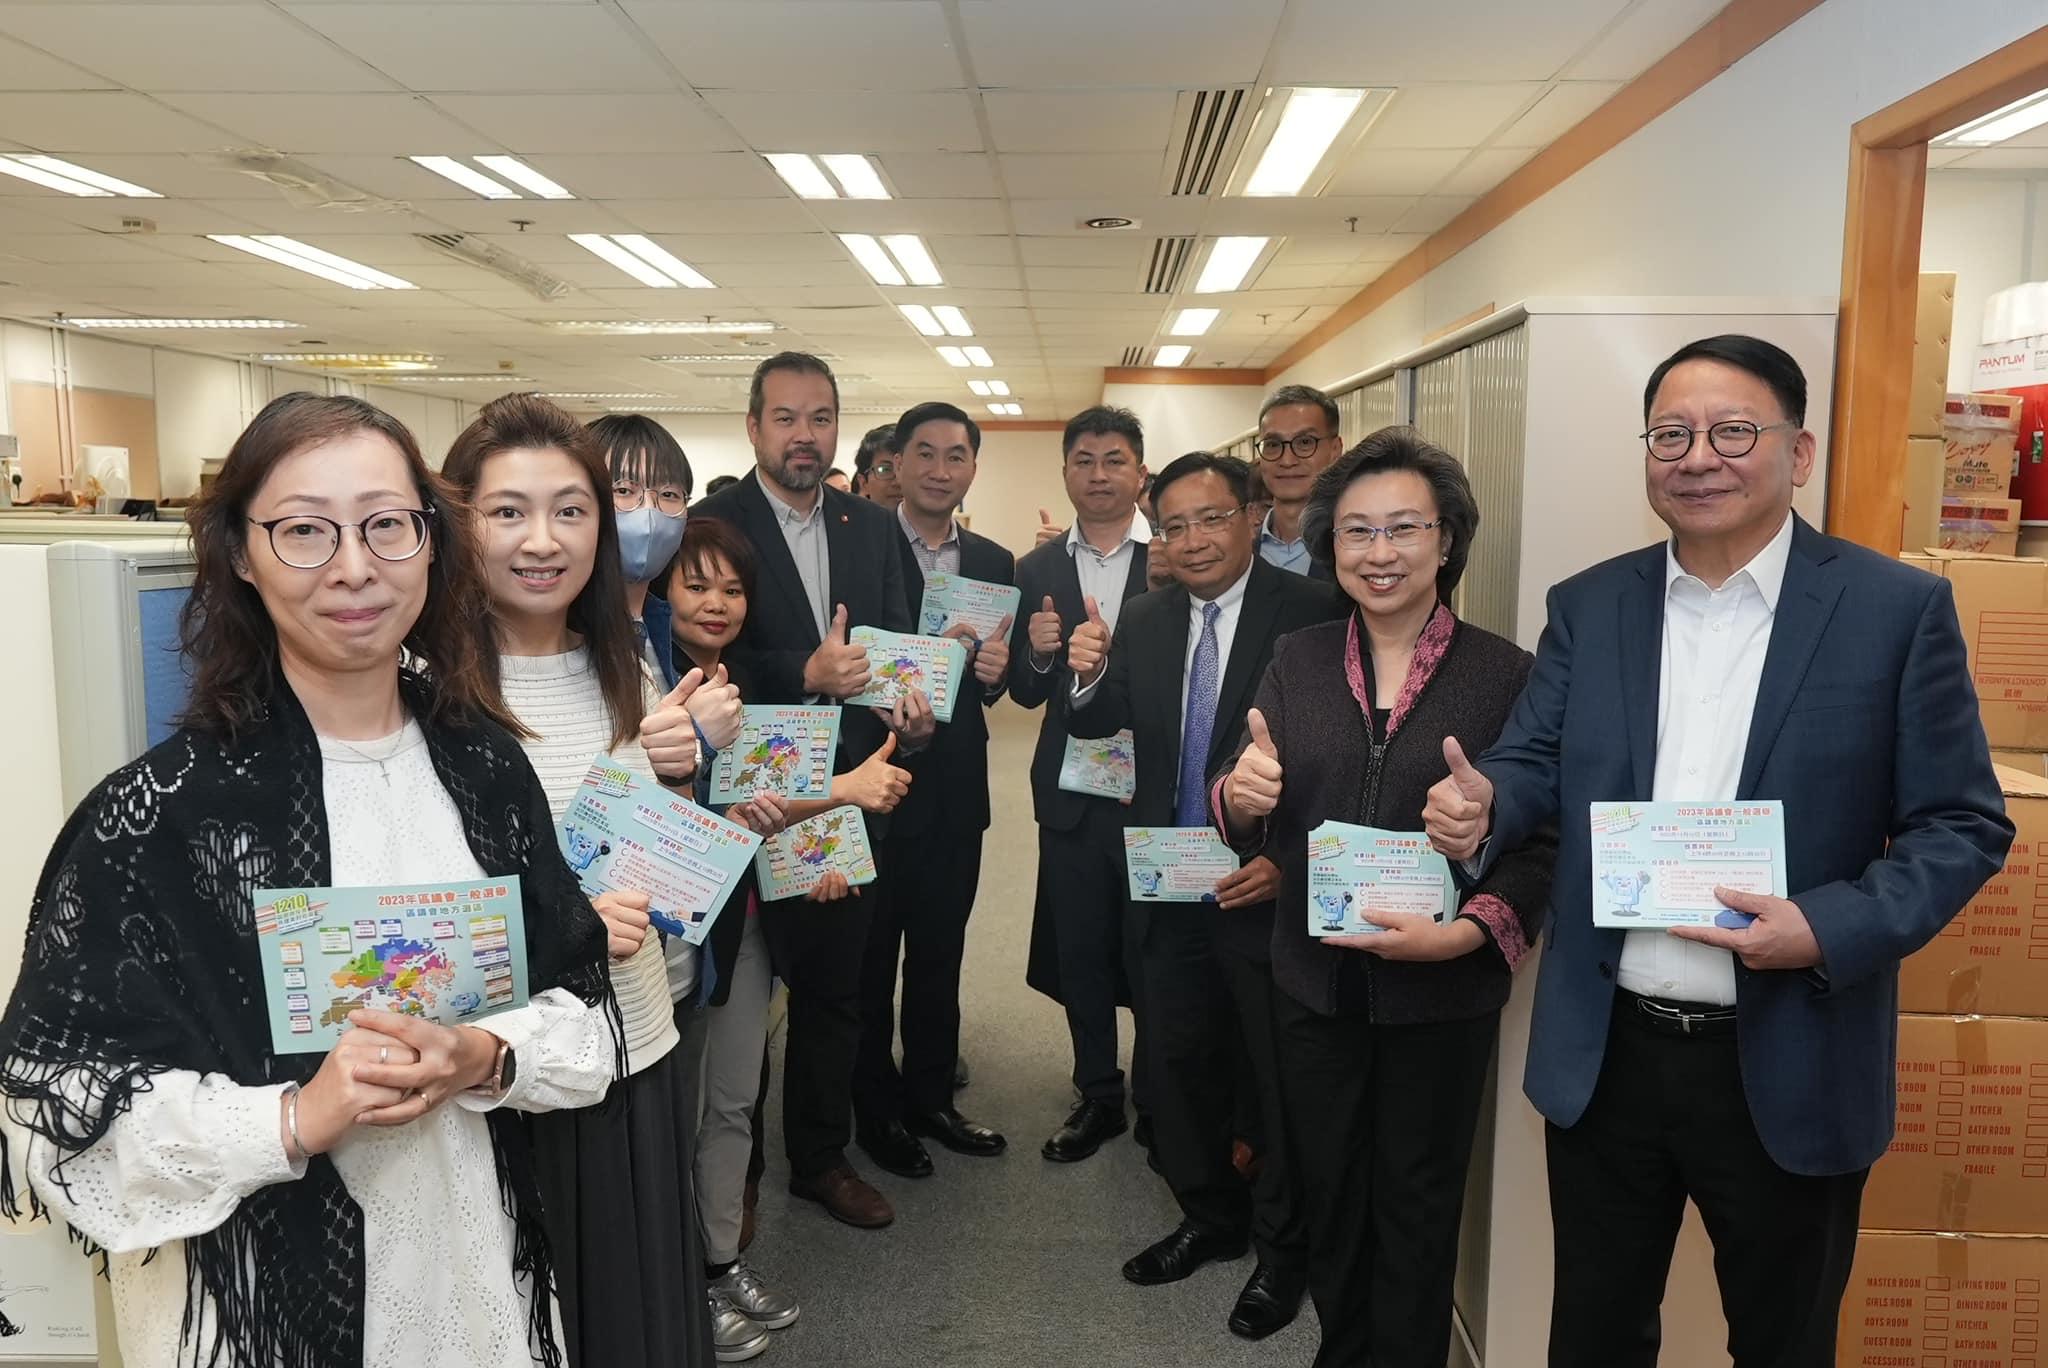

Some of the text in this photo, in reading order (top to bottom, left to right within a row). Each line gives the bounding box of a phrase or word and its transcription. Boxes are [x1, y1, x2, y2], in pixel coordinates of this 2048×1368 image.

[1979, 354, 2025, 368] PANTUM
[2012, 678, 2046, 686] CONTACT
[1677, 808, 1770, 816] 2023年區議會一般選舉
[2012, 844, 2029, 854] OOM
[2007, 865, 2030, 875] ROOM
[378, 886, 507, 906] 2023年區議會一般選舉
[273, 894, 306, 913] 1210
[406, 903, 483, 917] 區議會地方選區
[1974, 906, 2018, 916] BATH ROOM
[1972, 926, 2021, 937] OTHER ROOM
[1970, 946, 2000, 956] FRAGILE
[1913, 1063, 1935, 1072] ROOM
[1972, 1065, 2021, 1074] LIVING ROOM
[1904, 1083, 1926, 1093] ROOM
[1971, 1085, 2022, 1095] DINING ROOM
[1900, 1103, 1922, 1112] ROOM
[1969, 1105, 2002, 1115] KITCHEN
[1903, 1123, 1925, 1132] ROOM
[1968, 1125, 2010, 1135] BATH ROOM
[1891, 1142, 1928, 1152] ESSORIES
[1966, 1145, 2014, 1155] OTHER ROOM
[1964, 1165, 1996, 1175] FRAGILE
[1866, 1278, 1920, 1288] MASTER ROOM
[1957, 1280, 2006, 1290] LIVING ROOM
[1866, 1298, 1912, 1308] GIRLS ROOM
[1956, 1300, 2007, 1310] DINING ROOM
[1864, 1318, 1908, 1328] BOYS ROOM
[1955, 1321, 1988, 1330] KITCHEN
[1864, 1337, 1912, 1347] GUEST ROOM
[1955, 1340, 1997, 1350] BATH ROOM
[1862, 1356, 1915, 1366] ACCESSORIES
[1953, 1360, 2001, 1368] OTHER ROOM
